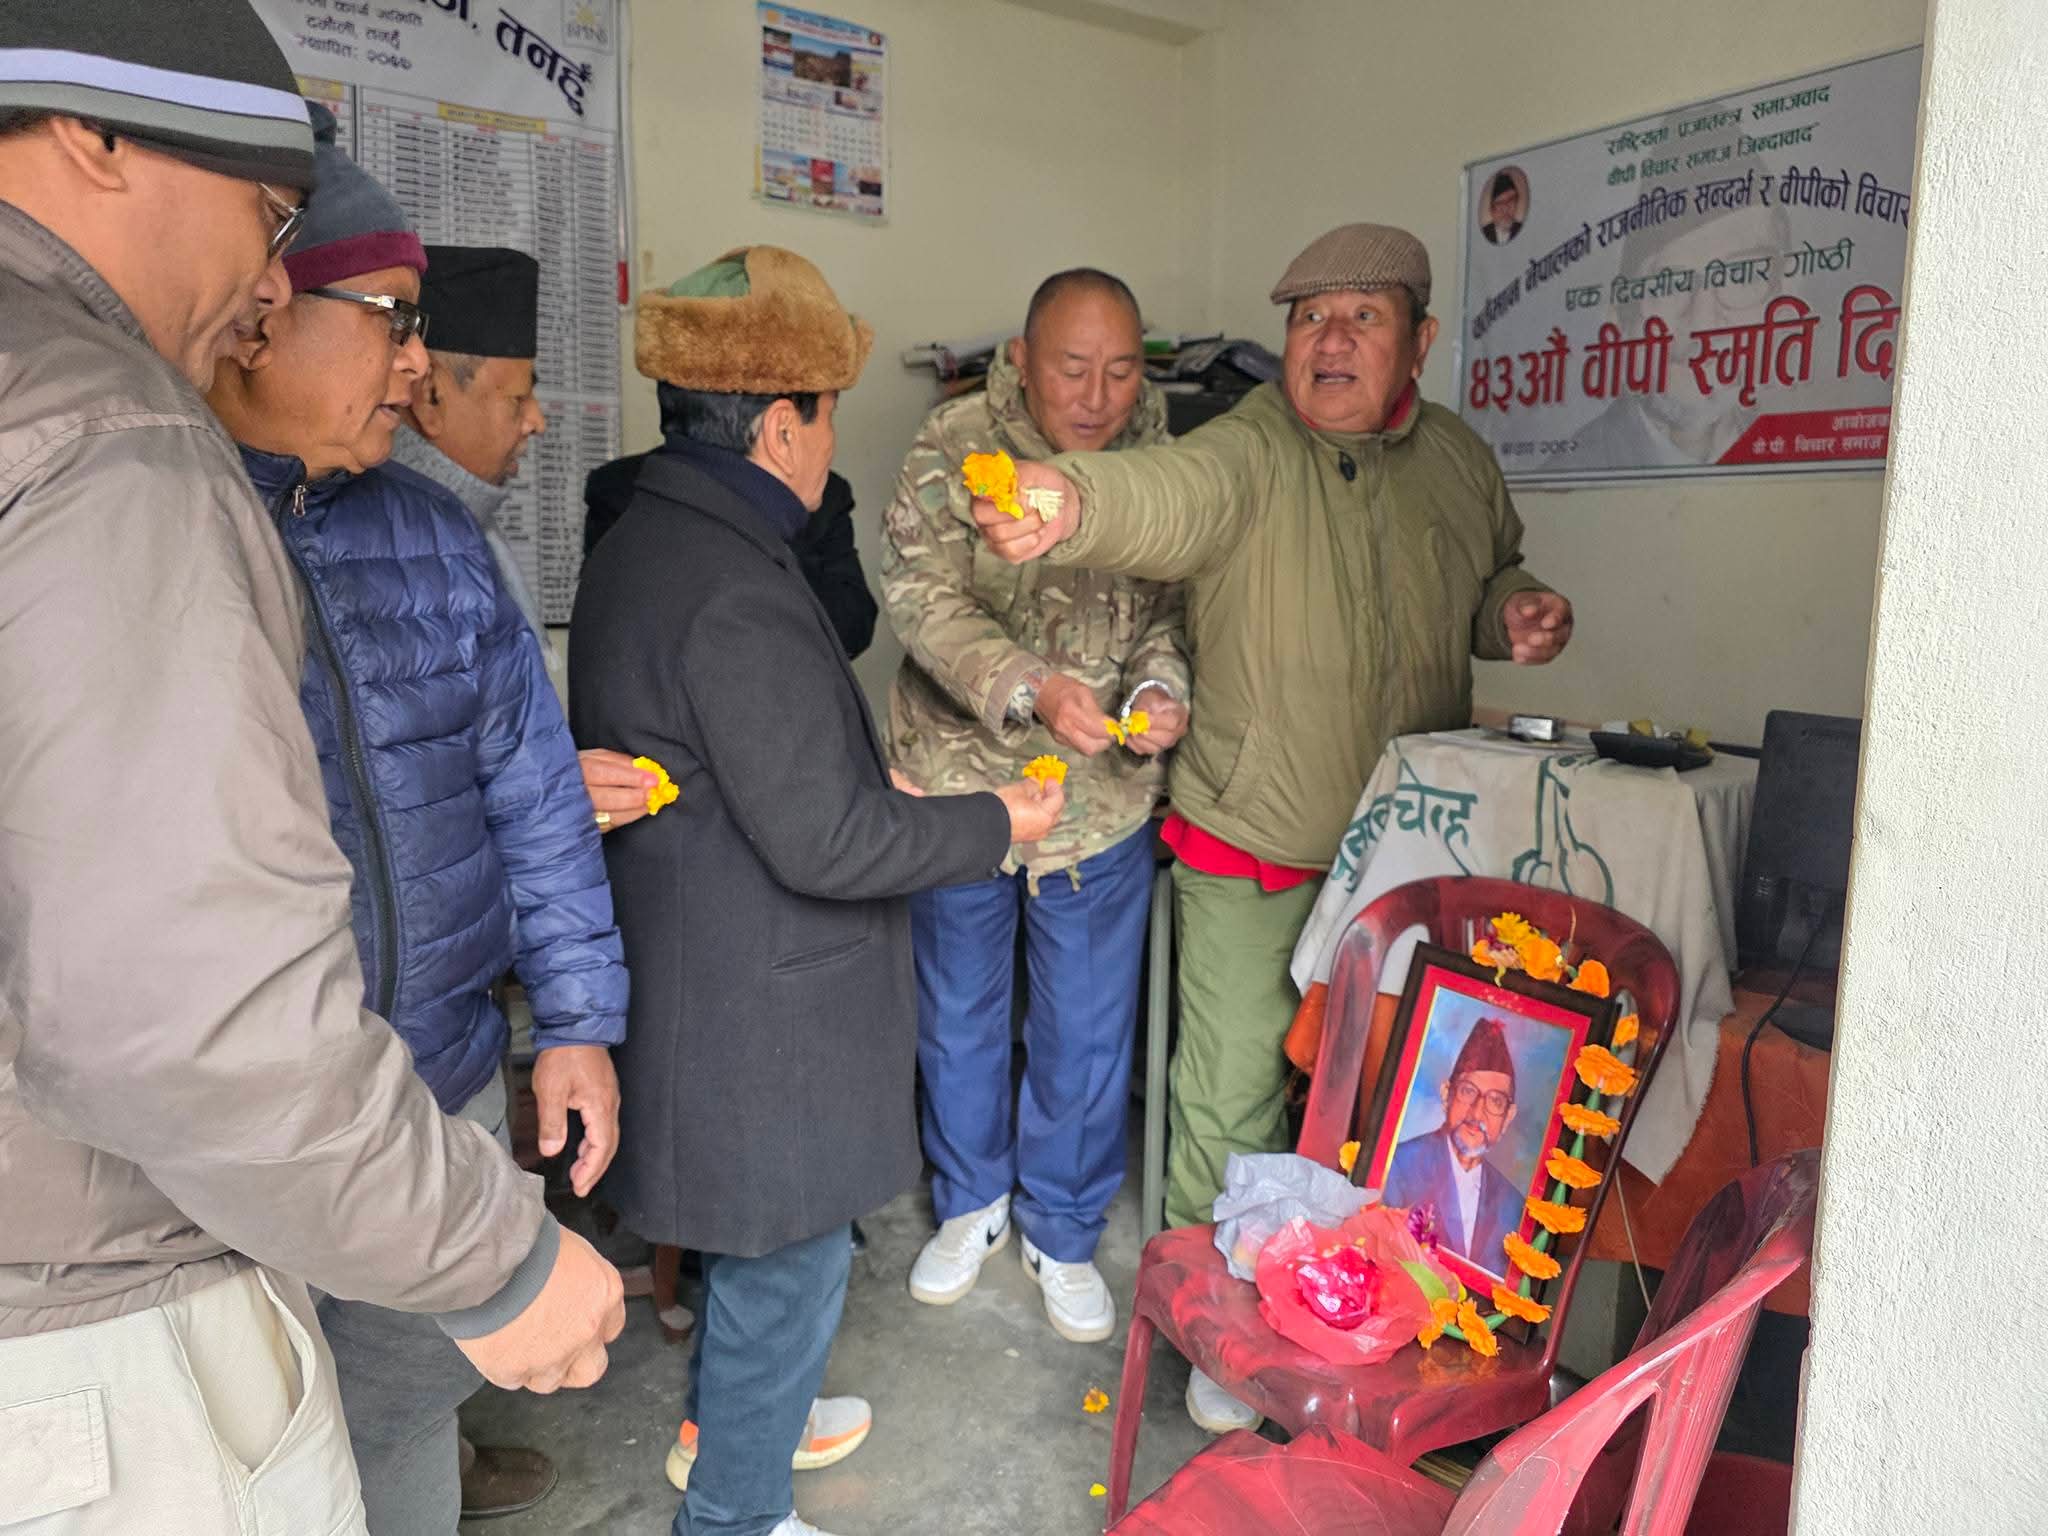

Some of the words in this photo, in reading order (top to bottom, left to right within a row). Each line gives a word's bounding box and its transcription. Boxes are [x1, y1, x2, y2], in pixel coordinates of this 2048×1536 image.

[496, 7, 594, 117] तनहुँ
[1597, 186, 1688, 248] राजनीतिक
[1694, 168, 1753, 214] सन्दर्भ
[1760, 175, 1774, 207] र
[1564, 283, 1602, 312] एक
[1610, 266, 1696, 305] दिवसीय
[1704, 258, 1772, 291] विचार
[1783, 236, 1855, 279] गोष्ठी
[1688, 295, 1821, 409] स्मृति
